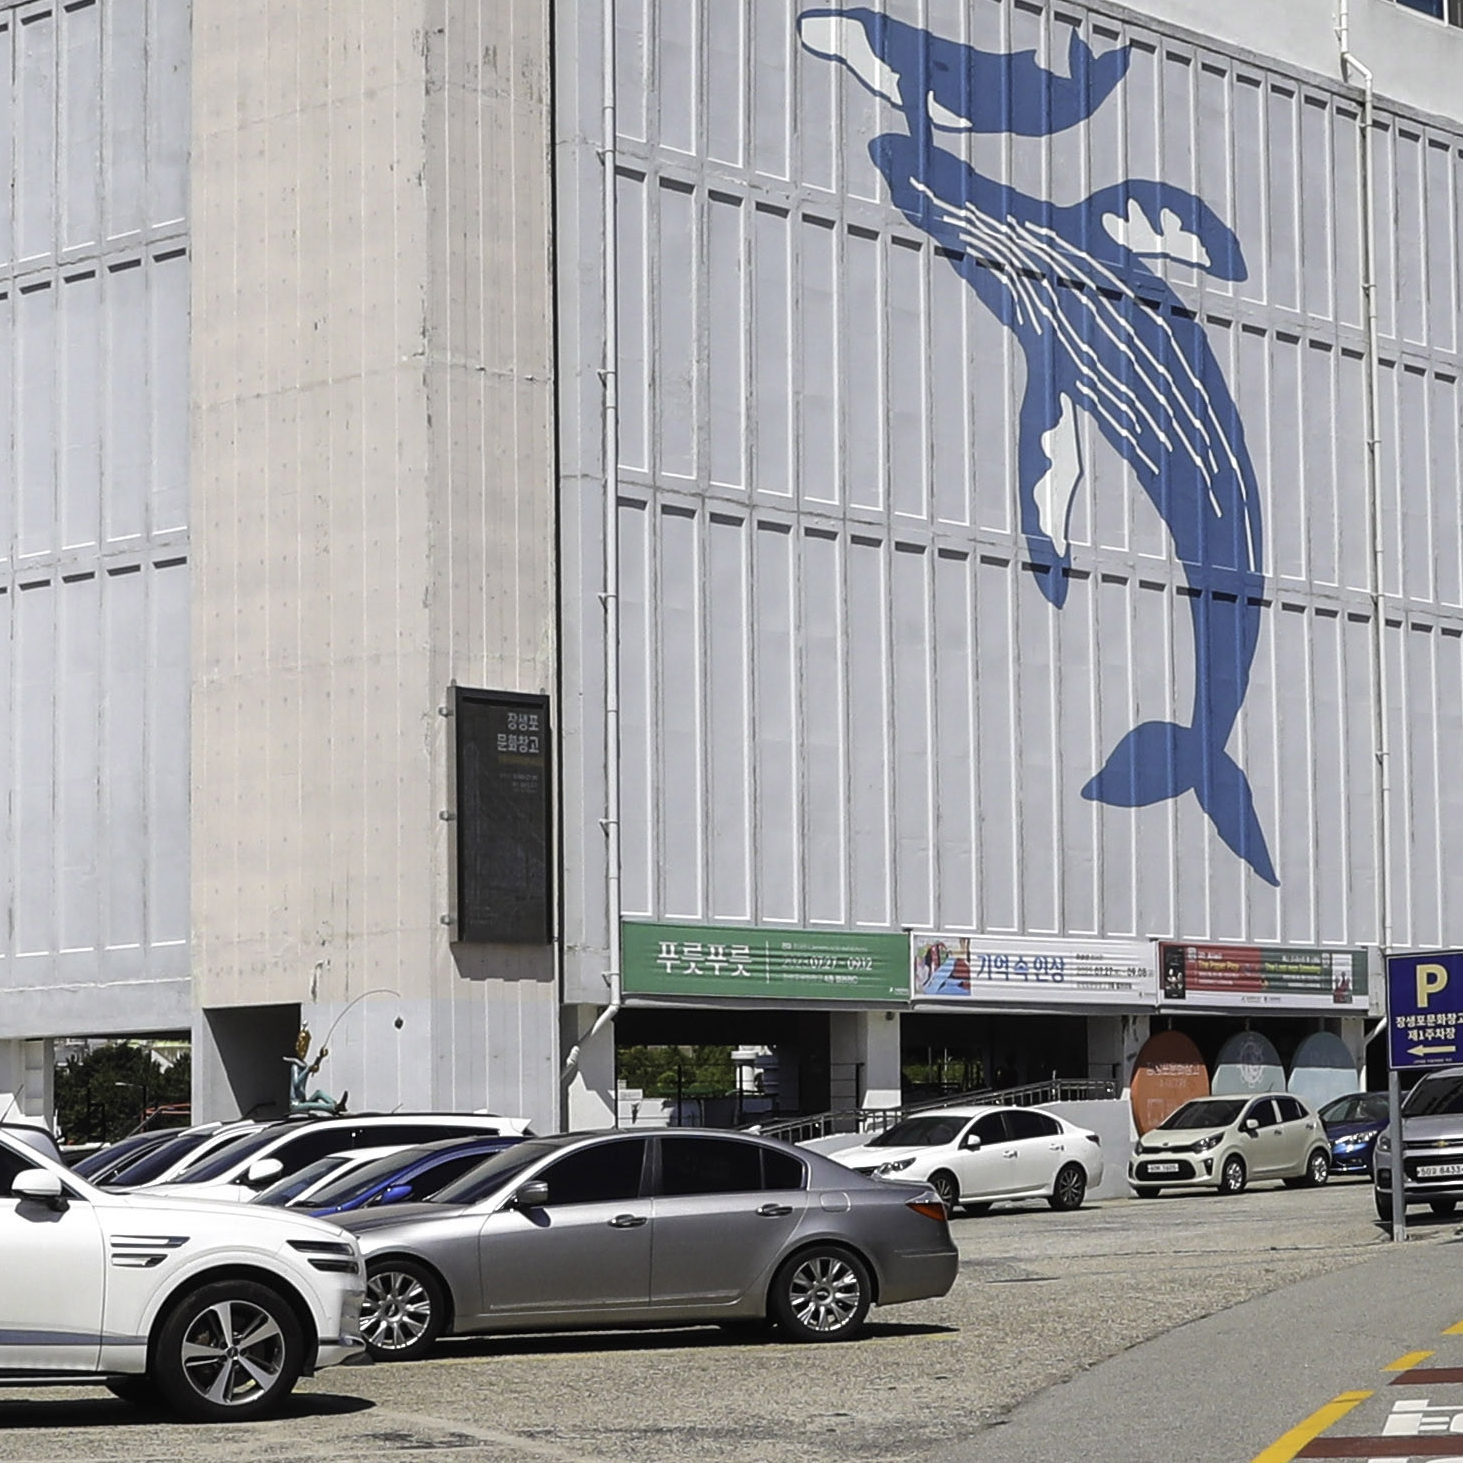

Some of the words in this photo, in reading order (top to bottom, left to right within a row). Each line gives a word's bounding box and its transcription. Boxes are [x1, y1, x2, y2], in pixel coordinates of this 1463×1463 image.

[507, 712, 539, 731] 장생포
[497, 733, 539, 753] 문화창고
[656, 940, 753, 977] 푸릇푸릇
[976, 953, 1009, 981] 기억
[1014, 955, 1030, 982] 속
[1416, 963, 1448, 1008] P
[1407, 1027, 1456, 1042] 제1주차장
